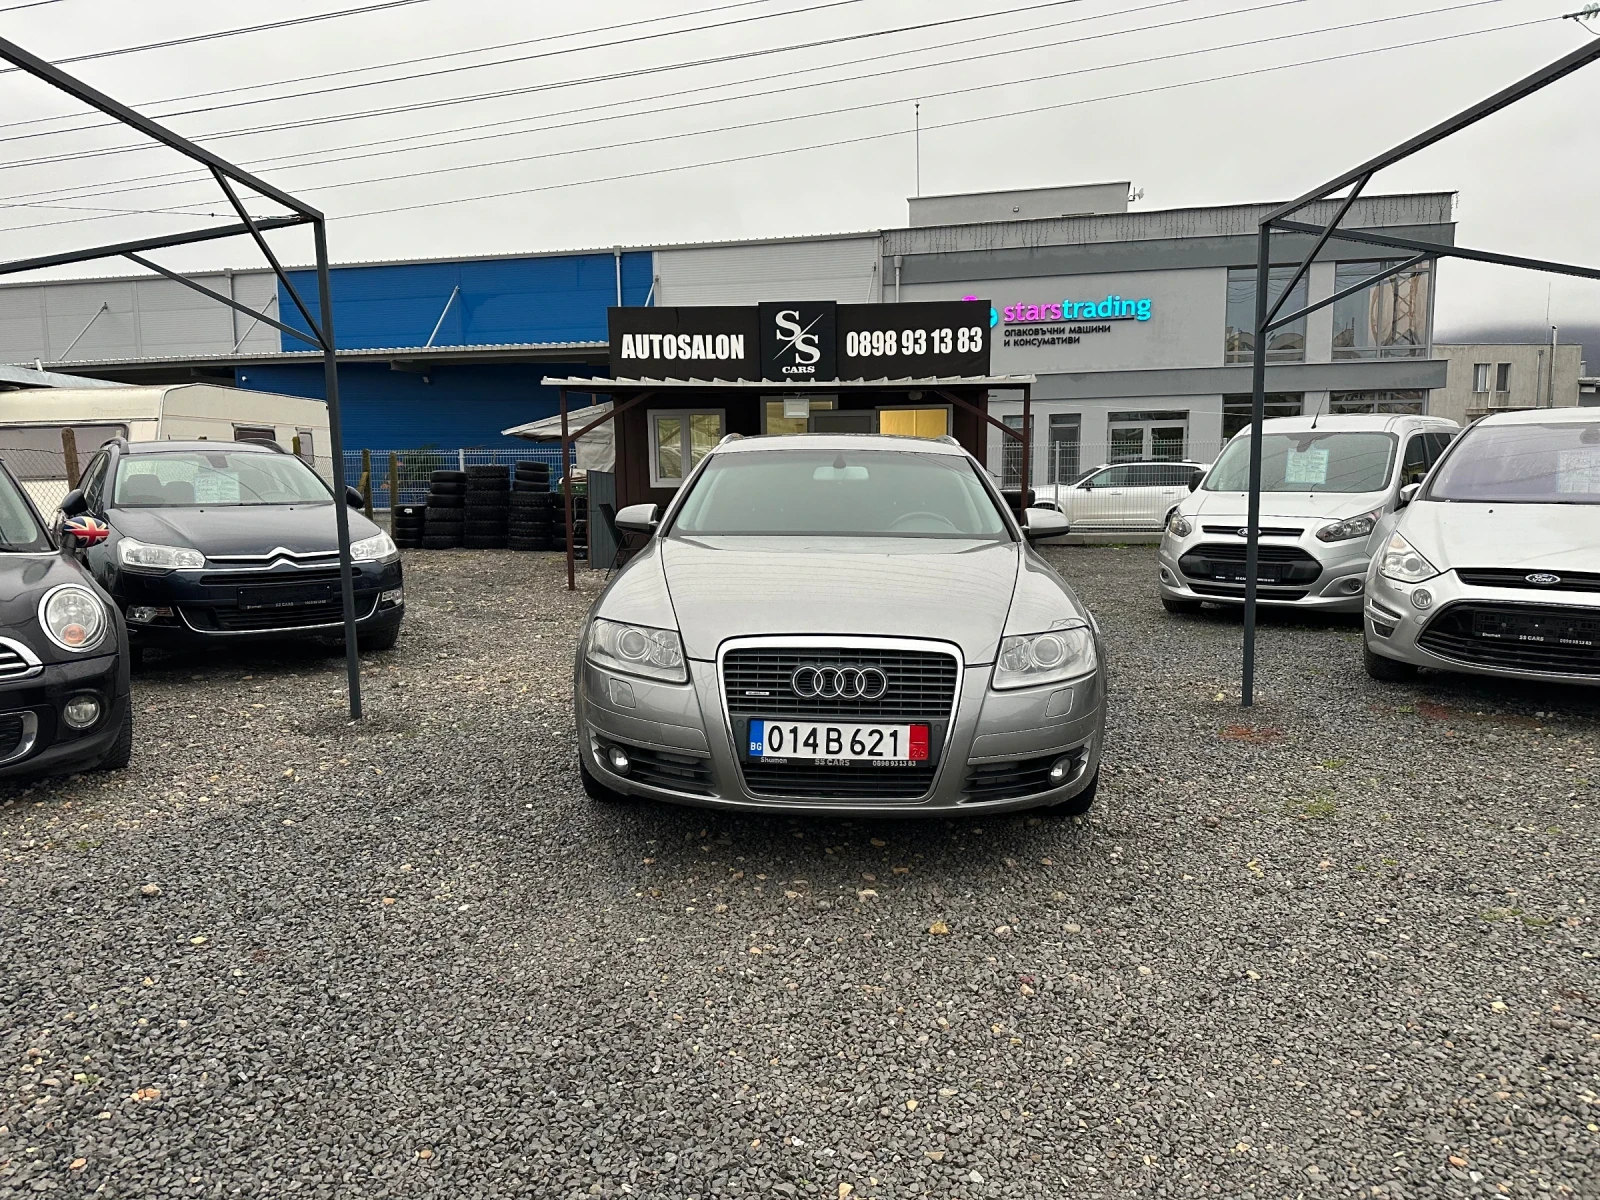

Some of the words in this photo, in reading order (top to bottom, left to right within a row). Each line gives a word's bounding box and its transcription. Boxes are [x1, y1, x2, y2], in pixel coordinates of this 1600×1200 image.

[1003, 295, 1152, 322] starstrading
[1004, 326, 1066, 338] опаковъчни
[1068, 324, 1111, 334] машини
[621, 333, 745, 360] AUTOSALON
[846, 329, 898, 358] 0898
[901, 328, 927, 356] 93
[930, 327, 952, 355] 13
[957, 326, 983, 353] 83
[1013, 336, 1081, 348] консумативи
[781, 365, 815, 374] CARS
[750, 741, 762, 751] BG
[827, 759, 850, 767] CARS
